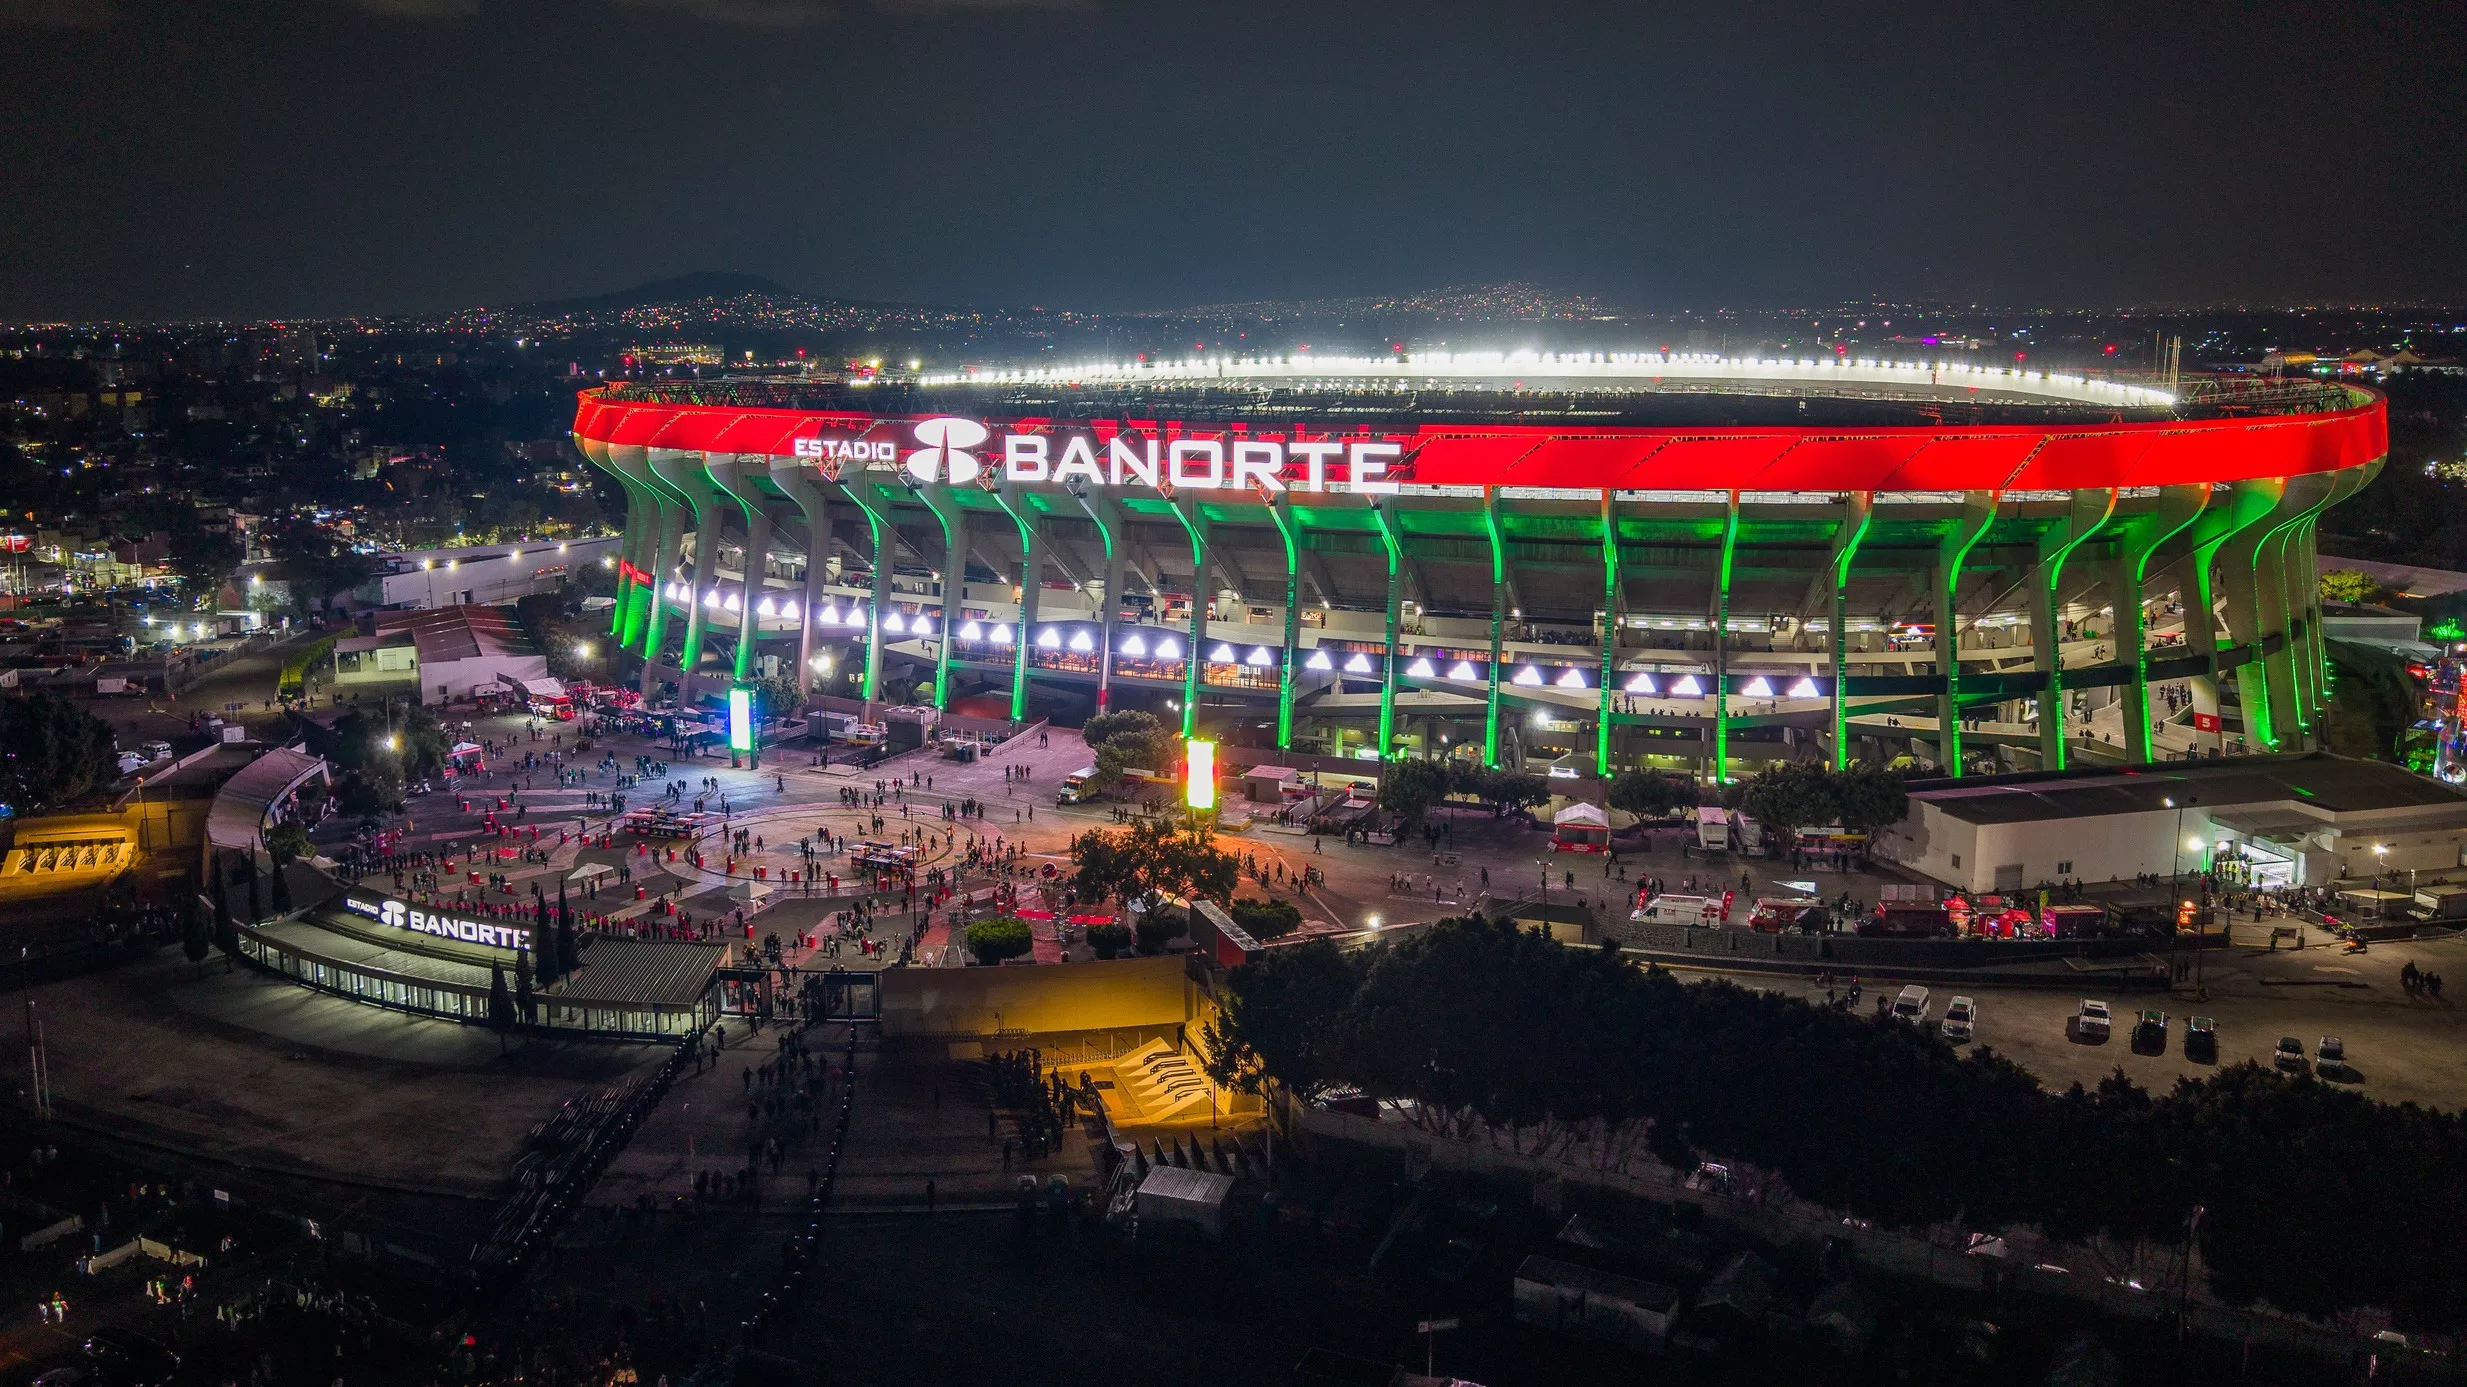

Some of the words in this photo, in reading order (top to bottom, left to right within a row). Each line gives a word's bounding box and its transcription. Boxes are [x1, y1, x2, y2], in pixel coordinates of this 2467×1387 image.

[795, 438, 897, 461] ESTADIO
[1005, 434, 1401, 494] BANORTE
[346, 898, 379, 915] ESTADIO
[409, 910, 531, 949] BANORTE
